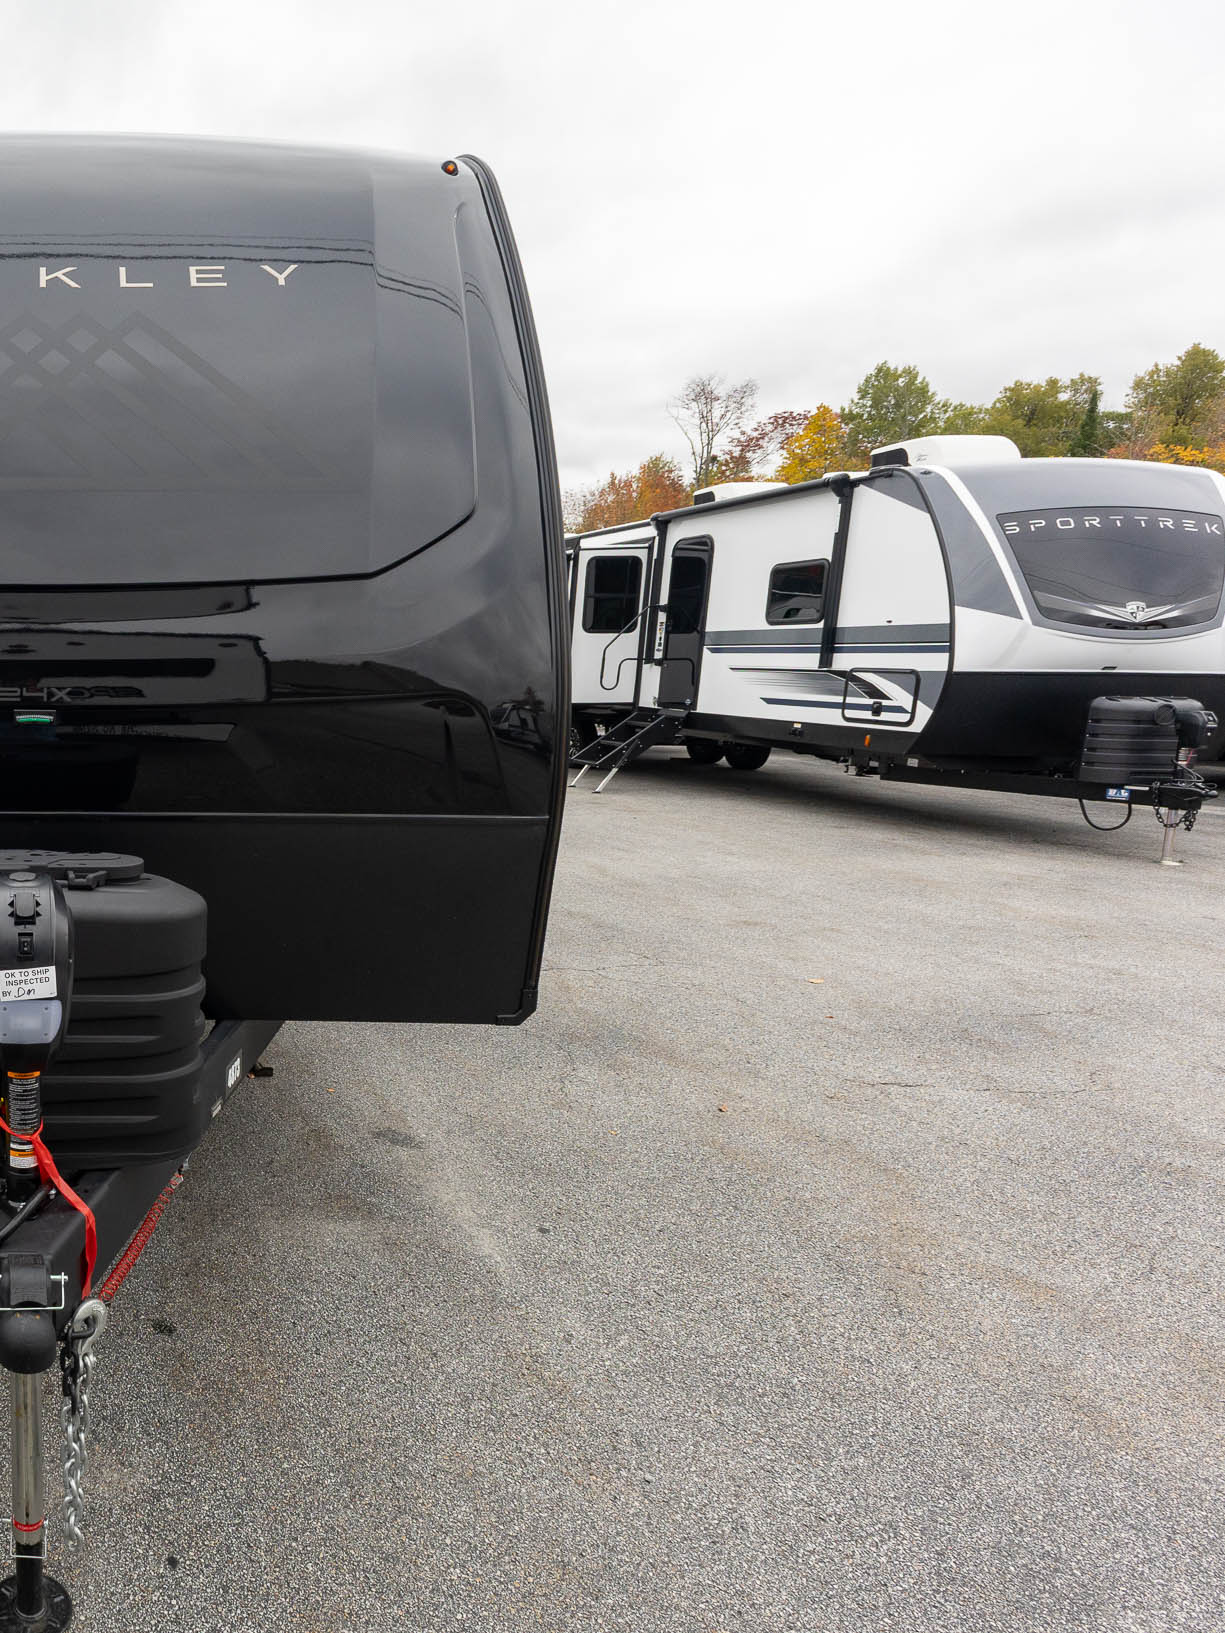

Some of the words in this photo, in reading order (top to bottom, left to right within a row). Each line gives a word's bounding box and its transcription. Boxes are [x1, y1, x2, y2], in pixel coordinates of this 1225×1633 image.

[1003, 515, 1222, 535] SPORTTREK
[4, 971, 16, 979] OK
[31, 968, 49, 976] SHIP
[5, 976, 50, 987] INSPECTED
